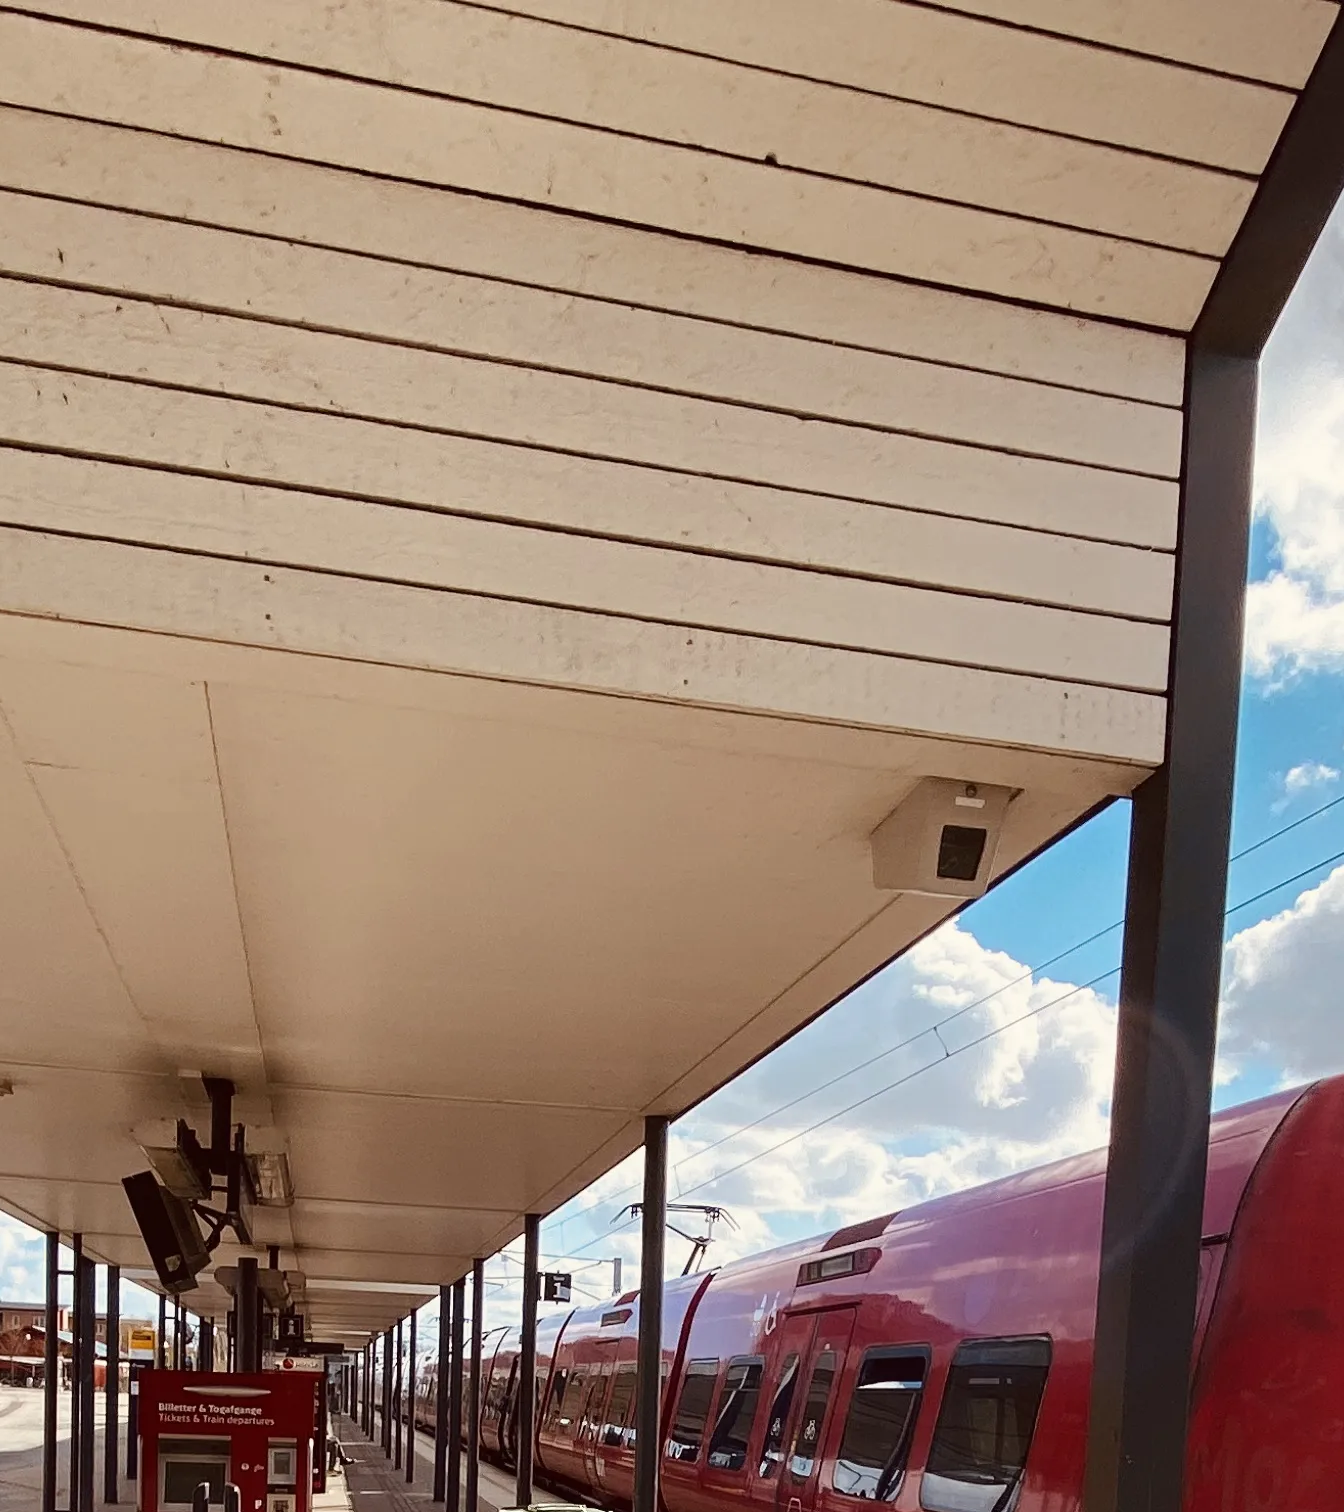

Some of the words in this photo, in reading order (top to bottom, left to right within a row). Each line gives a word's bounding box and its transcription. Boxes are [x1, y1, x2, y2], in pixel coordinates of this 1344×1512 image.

[158, 1402, 197, 1412] Billetter
[199, 1404, 207, 1413] &
[208, 1404, 262, 1416] Togafgange
[159, 1413, 190, 1423] Tickets
[193, 1414, 201, 1423] &
[204, 1414, 225, 1424] Train
[227, 1415, 275, 1426] departures
